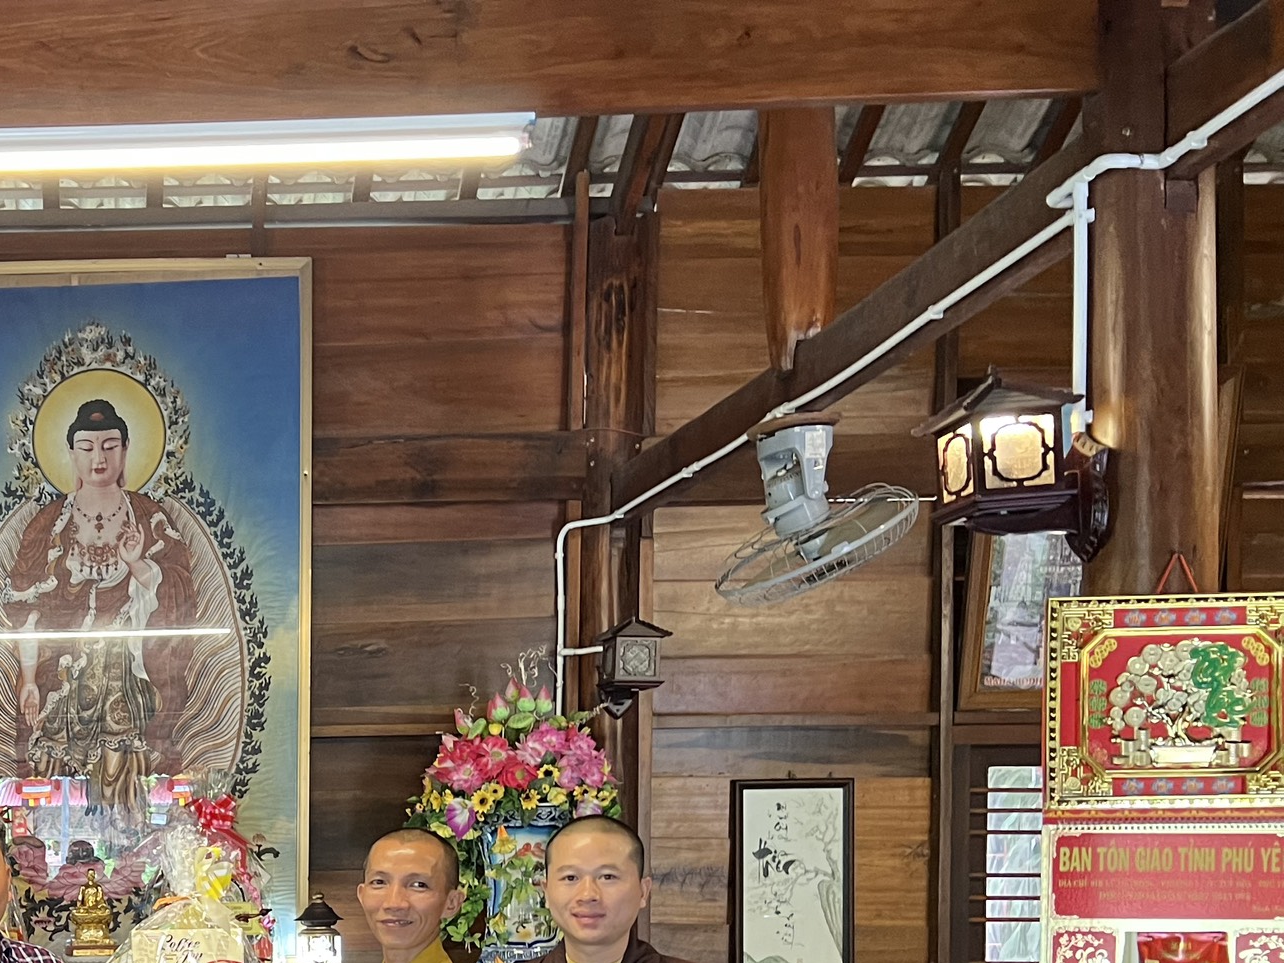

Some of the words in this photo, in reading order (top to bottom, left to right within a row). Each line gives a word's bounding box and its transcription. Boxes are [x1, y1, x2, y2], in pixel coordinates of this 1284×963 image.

[1059, 847, 1092, 872] BAN
[1097, 842, 1129, 872] TÔN
[1134, 843, 1173, 872] GIÁO
[1178, 840, 1215, 872] TỈNH
[1221, 841, 1254, 872] PHÚ
[1260, 841, 1284, 872] YÊ
